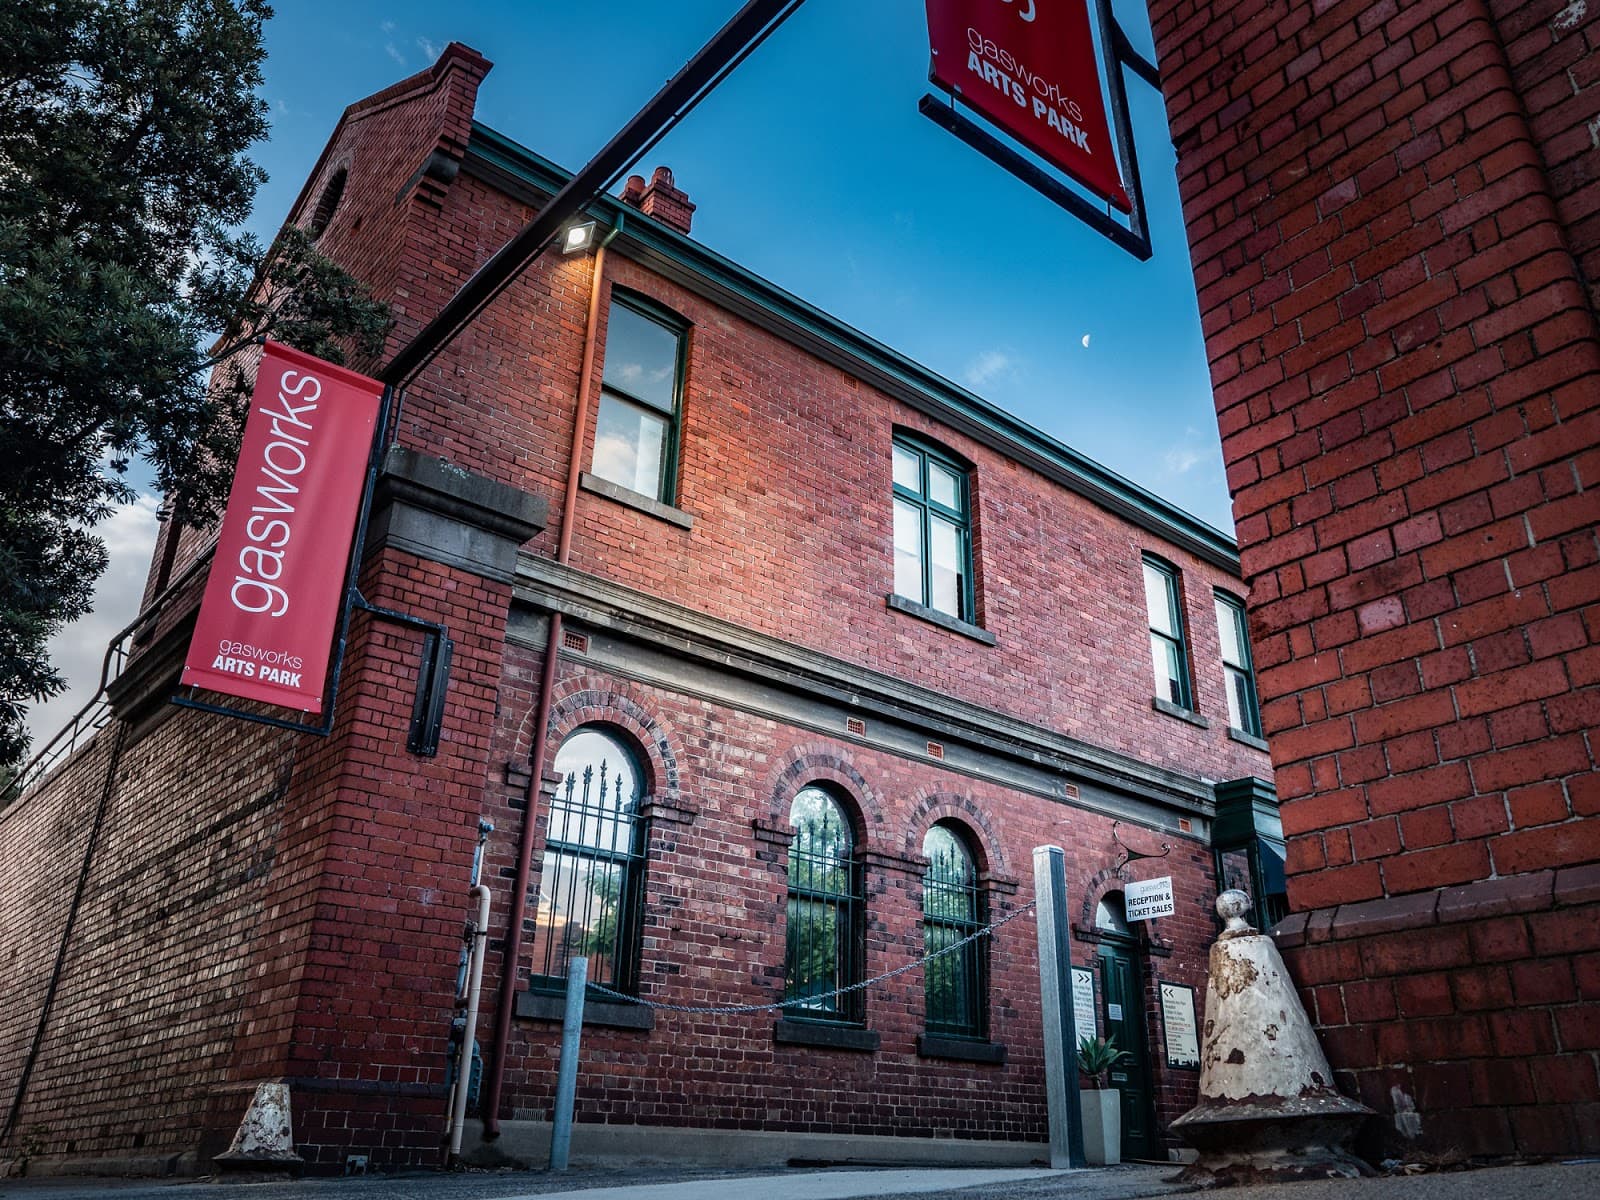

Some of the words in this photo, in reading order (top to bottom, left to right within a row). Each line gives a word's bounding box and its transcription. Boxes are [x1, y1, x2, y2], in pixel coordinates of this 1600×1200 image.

[967, 27, 1083, 122] gasworks
[967, 50, 1027, 108] ARTS
[1032, 95, 1092, 155] PARK
[230, 370, 322, 618] gasworks
[211, 654, 256, 677] ARTS
[258, 665, 303, 688] PARK
[219, 639, 303, 670] gasworks
[1127, 893, 1164, 907] RECEPTION
[1165, 892, 1171, 901] &
[1127, 907, 1150, 918] TICKET
[1151, 903, 1173, 914] SALES
